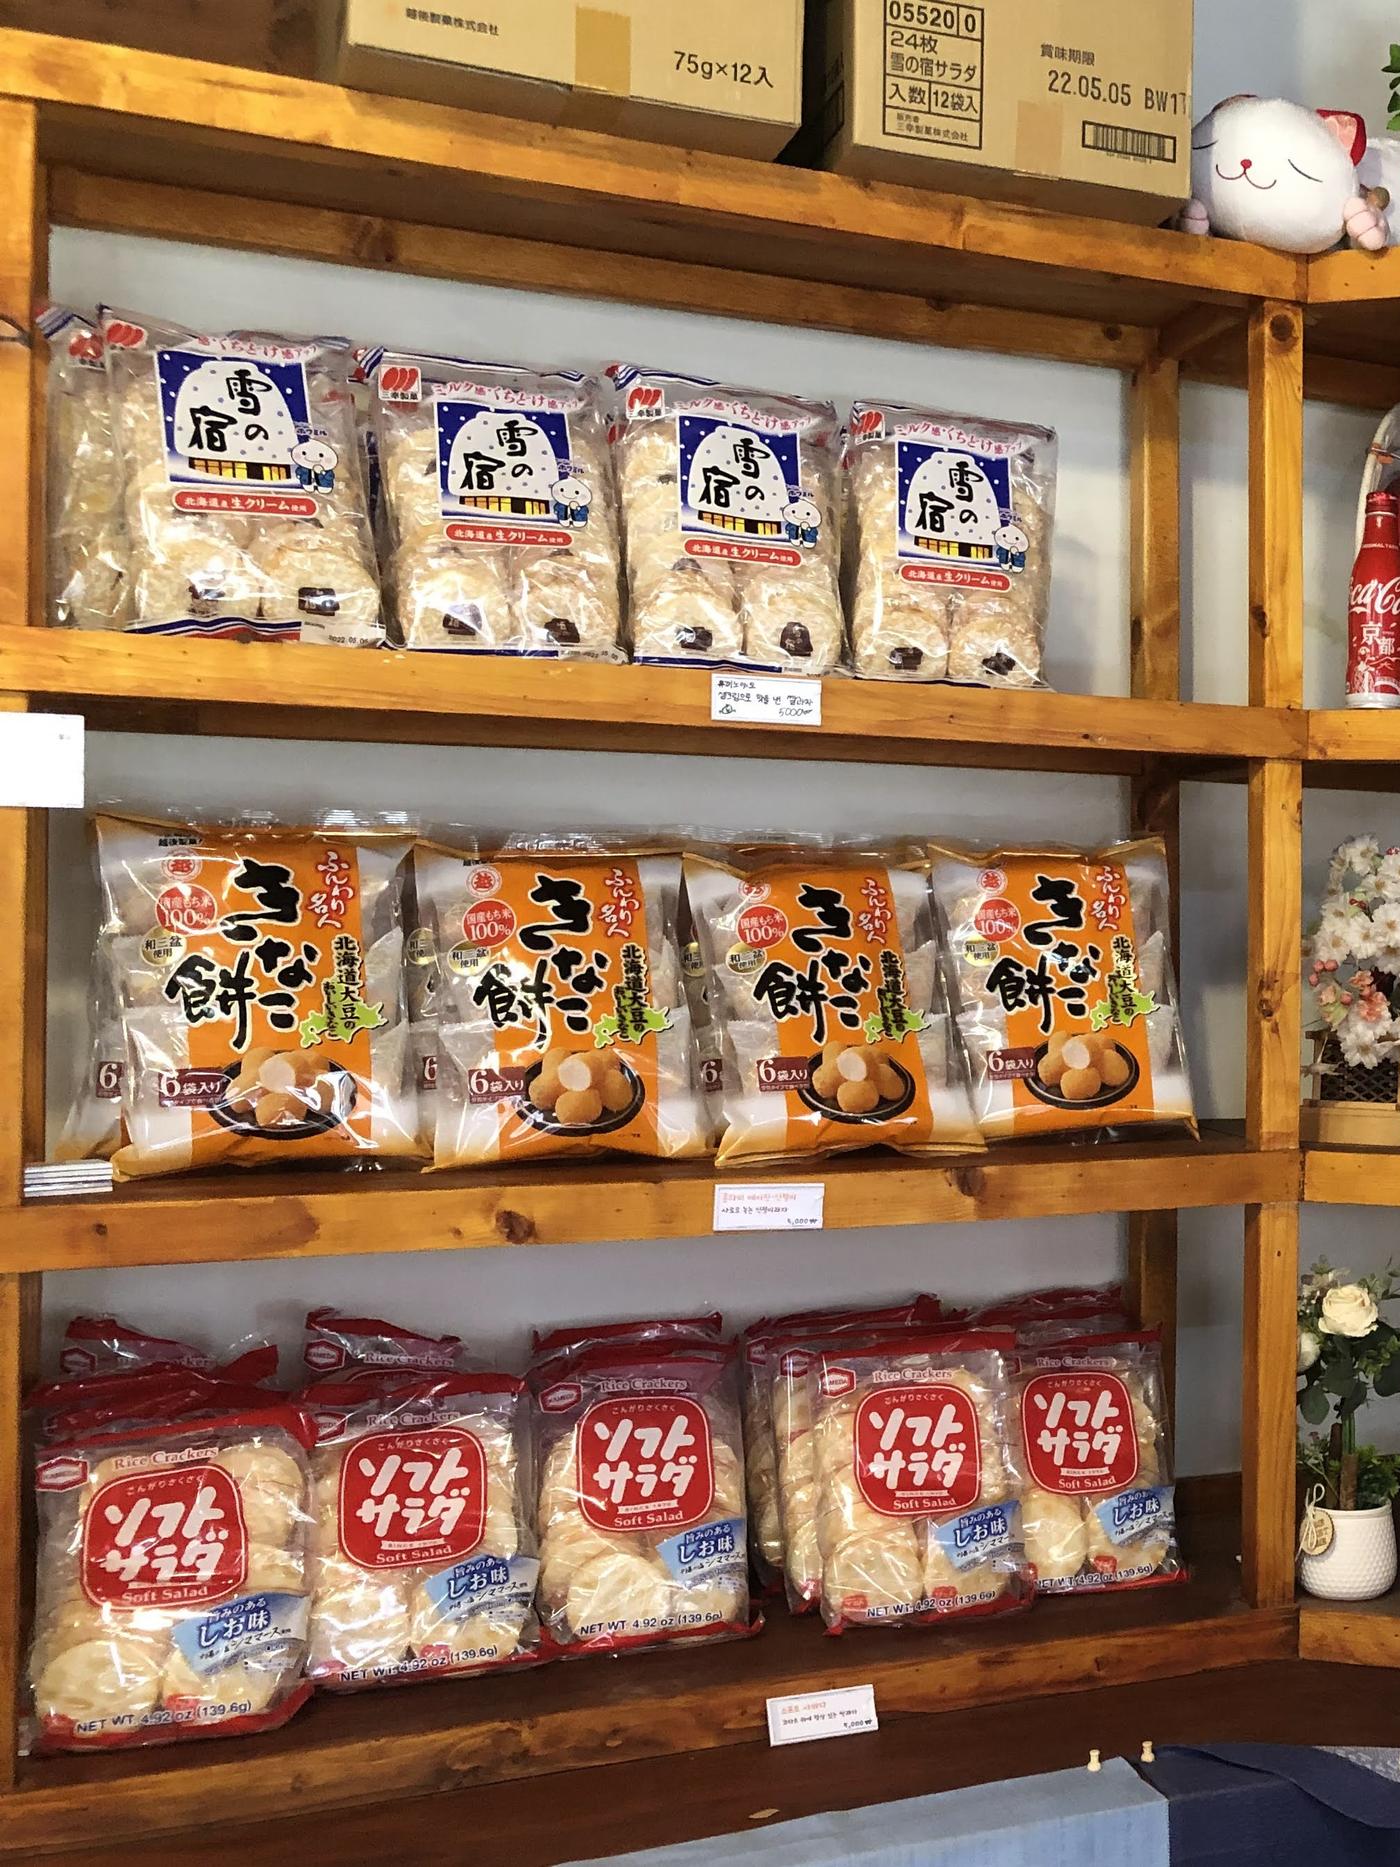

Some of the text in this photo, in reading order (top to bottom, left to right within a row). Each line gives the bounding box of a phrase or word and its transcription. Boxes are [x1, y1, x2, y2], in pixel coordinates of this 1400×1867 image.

[889, 0, 976, 33] 05520 0
[890, 30, 939, 55] 24枚
[1040, 42, 1096, 67] 賞味期限
[890, 52, 977, 83] 雪の宿サラダ
[888, 82, 926, 106] 入数
[1048, 69, 1132, 107] 22.05.05
[468, 922, 512, 941] 100%
[744, 927, 785, 944] 100%
[758, 1060, 809, 1083] 6袋入り
[986, 1051, 1035, 1072] 6袋入り
[160, 1072, 221, 1098] 6袋入り
[469, 1069, 525, 1095] 6袋入り
[1036, 1356, 1117, 1368] Rice Crackers
[600, 1377, 688, 1392] Rice Crackers
[873, 1367, 954, 1383] Rice Crackers
[367, 1410, 461, 1427] Rice Crackers
[1034, 1390, 1120, 1430] ソフト
[594, 1415, 696, 1462] ソフト
[869, 1404, 963, 1451] ソフト
[1037, 1424, 1123, 1466] サラダ
[114, 1446, 219, 1471] Rice Crackers
[868, 1443, 967, 1490] サラダ
[358, 1448, 470, 1497] ソフト
[592, 1455, 698, 1504] サラダ
[1058, 1475, 1117, 1489] Soft Salad
[355, 1486, 471, 1538] サラダ
[893, 1496, 956, 1509] Soft Salad
[1113, 1496, 1161, 1527] しお味
[104, 1486, 225, 1547] ソフト
[614, 1510, 684, 1528] Soft Salad
[954, 1517, 1007, 1548] しお味
[101, 1526, 229, 1581] サラダ
[376, 1545, 453, 1565] Soft Salad
[678, 1535, 734, 1564] しお味
[121, 1585, 208, 1604] Soft Salad
[448, 1565, 509, 1599] しお味
[867, 1606, 890, 1618] NET
[199, 1608, 270, 1649] しお味
[580, 1617, 674, 1636] NET 4.92 oz
[431, 1657, 447, 1667] oz
